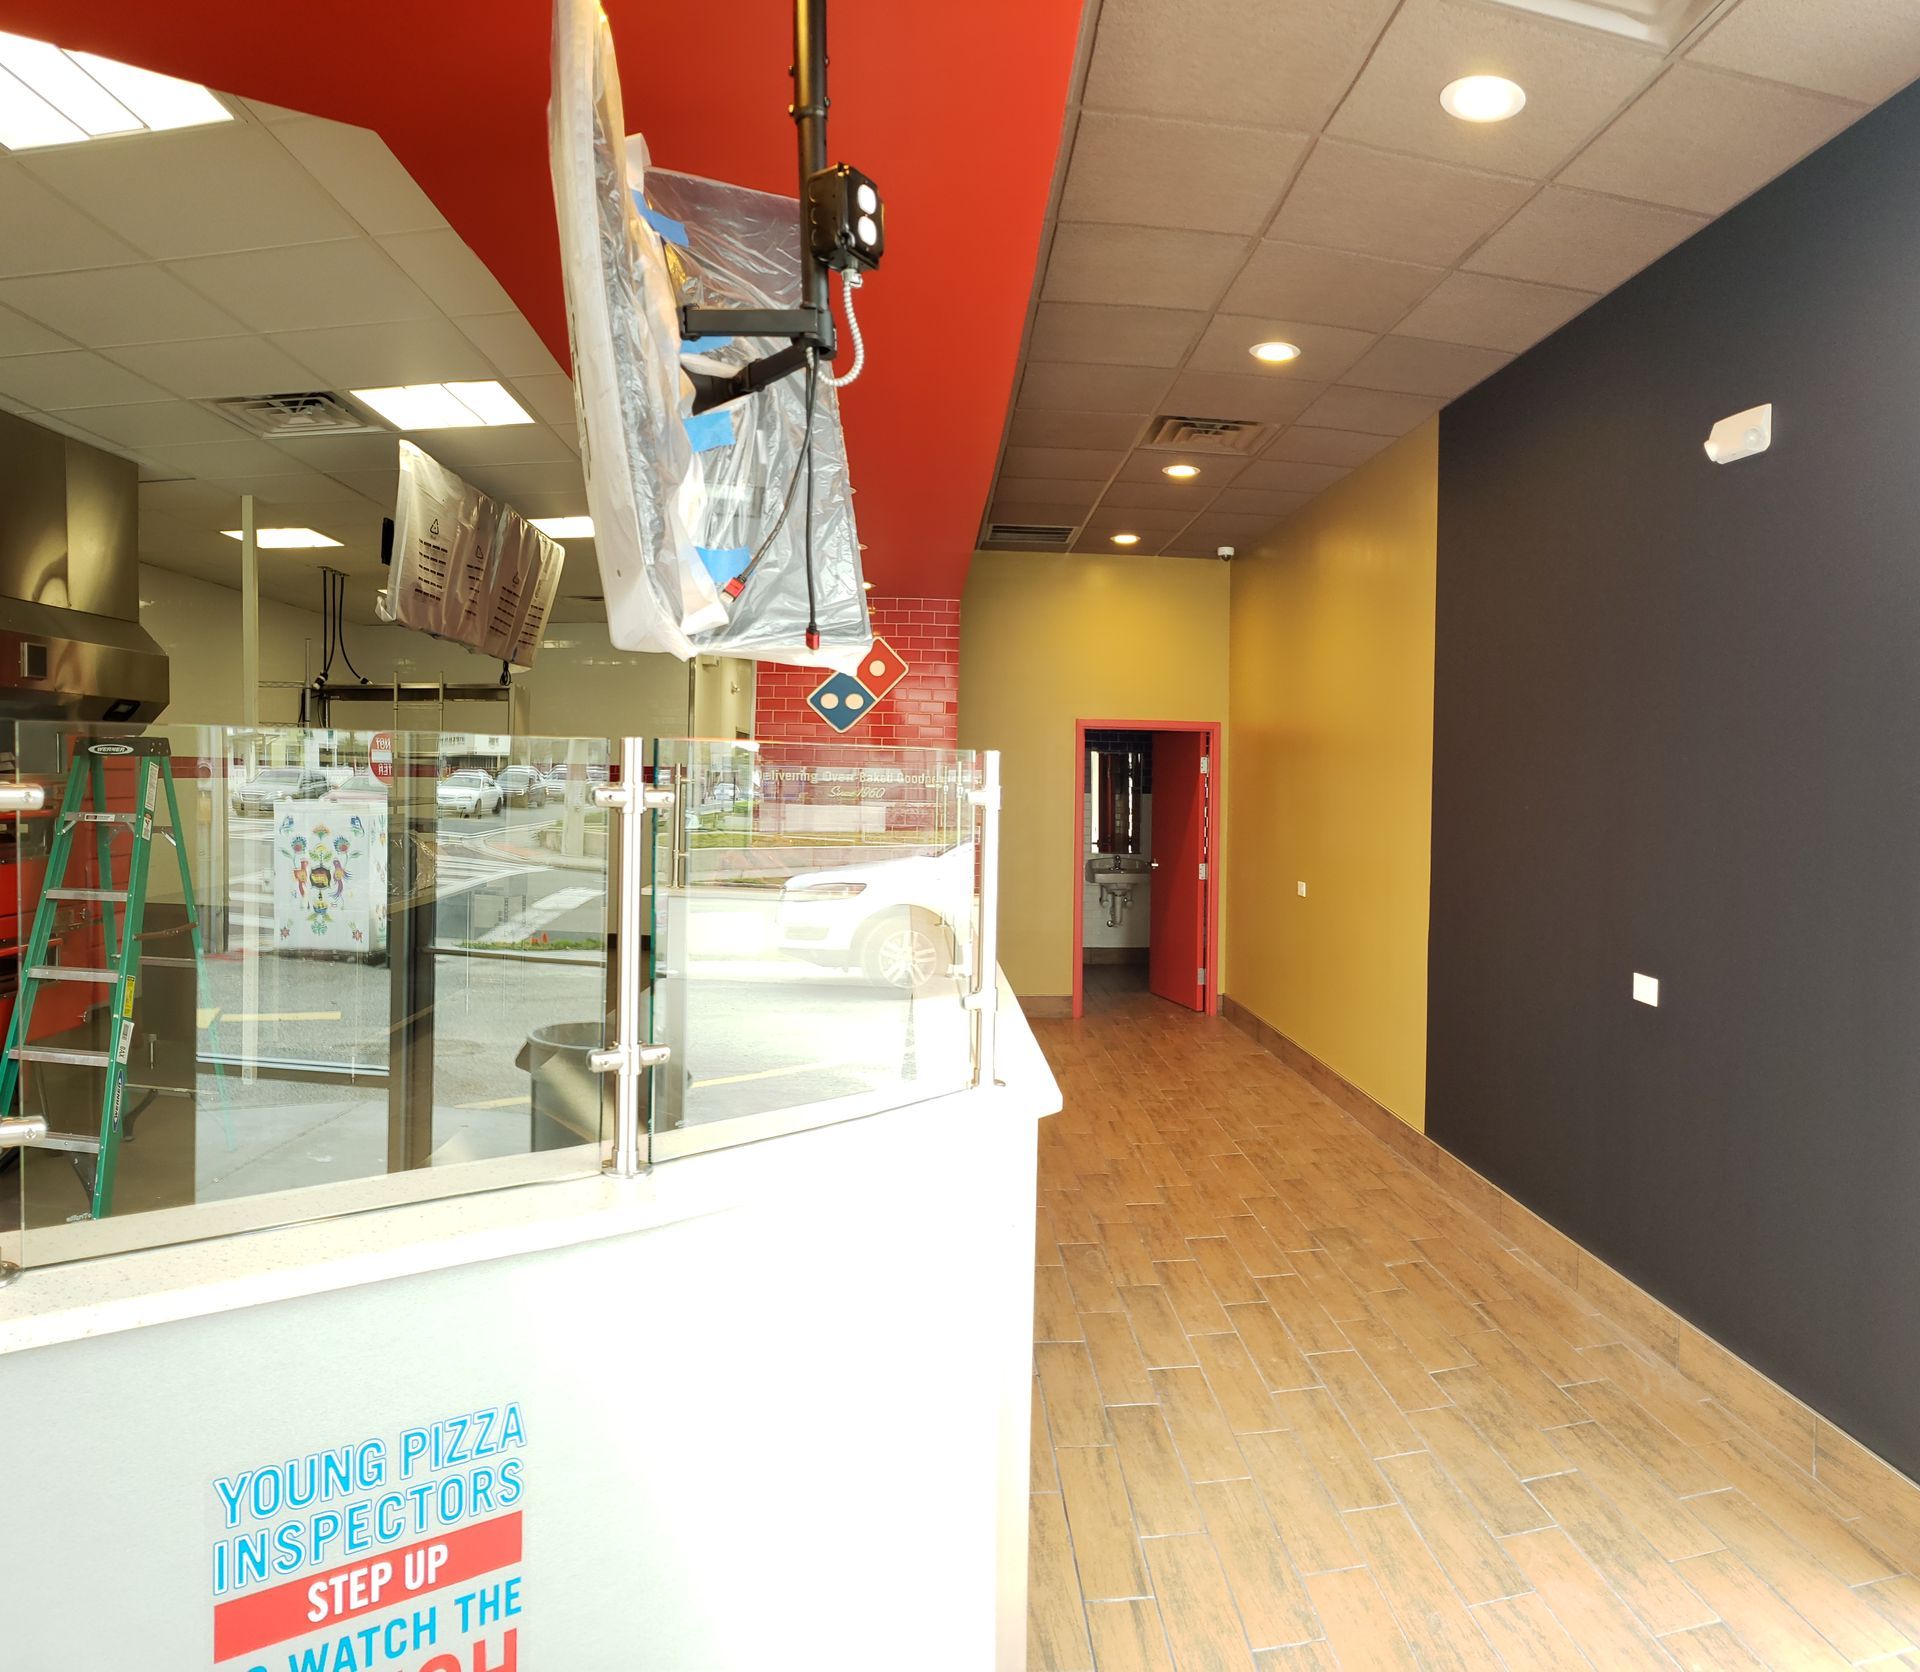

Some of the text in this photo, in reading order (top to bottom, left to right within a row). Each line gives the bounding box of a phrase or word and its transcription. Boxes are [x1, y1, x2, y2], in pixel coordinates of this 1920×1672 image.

[212, 1401, 528, 1529] YOUNG PIZZA
[212, 1457, 524, 1597] INSPECTORS
[306, 1543, 449, 1623] STEP UP
[288, 1606, 437, 1672] WATCH
[454, 1576, 522, 1634] THE
